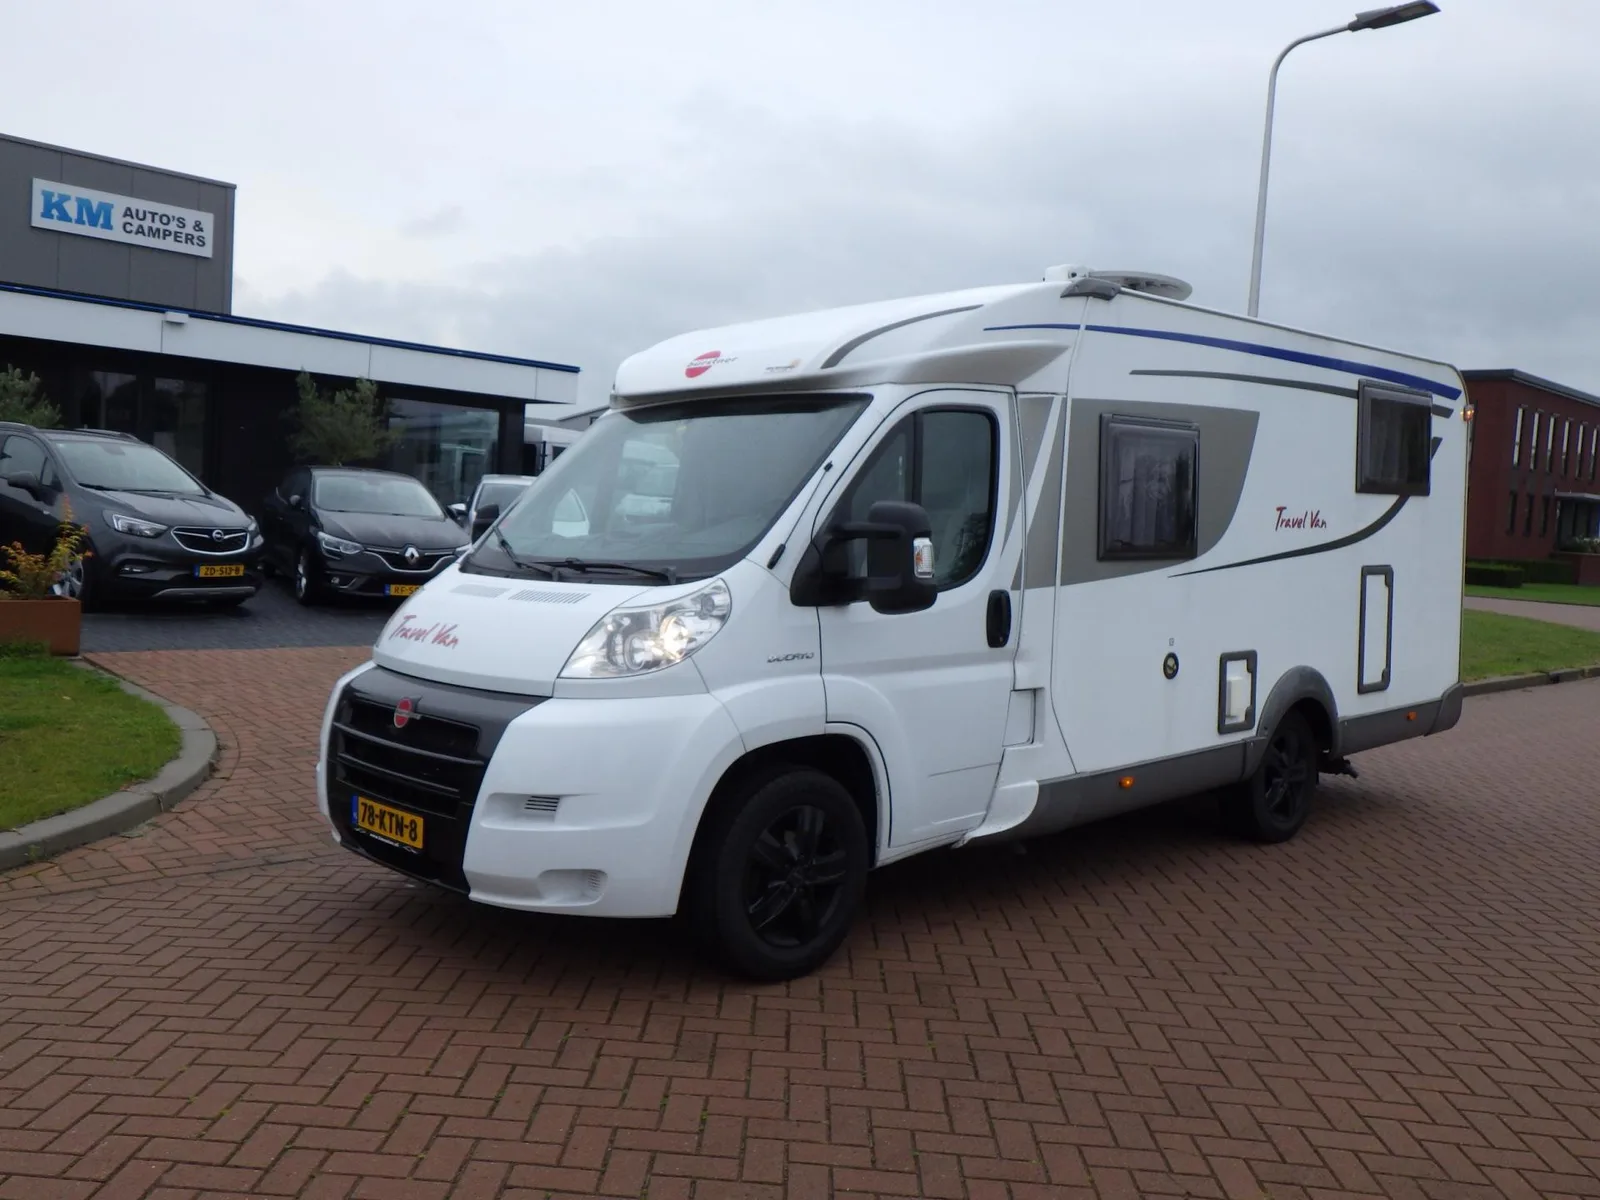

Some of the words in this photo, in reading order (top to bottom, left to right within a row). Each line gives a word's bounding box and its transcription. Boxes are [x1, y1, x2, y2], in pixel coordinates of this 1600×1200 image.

[40, 189, 114, 231] KM
[122, 222, 206, 248] CAMPERS
[192, 220, 204, 233] &
[1275, 506, 1308, 531] Travel
[1310, 509, 1327, 529] Van
[388, 614, 440, 643] Travel
[431, 623, 459, 650] Van
[361, 802, 418, 843] 78-KTN-8
